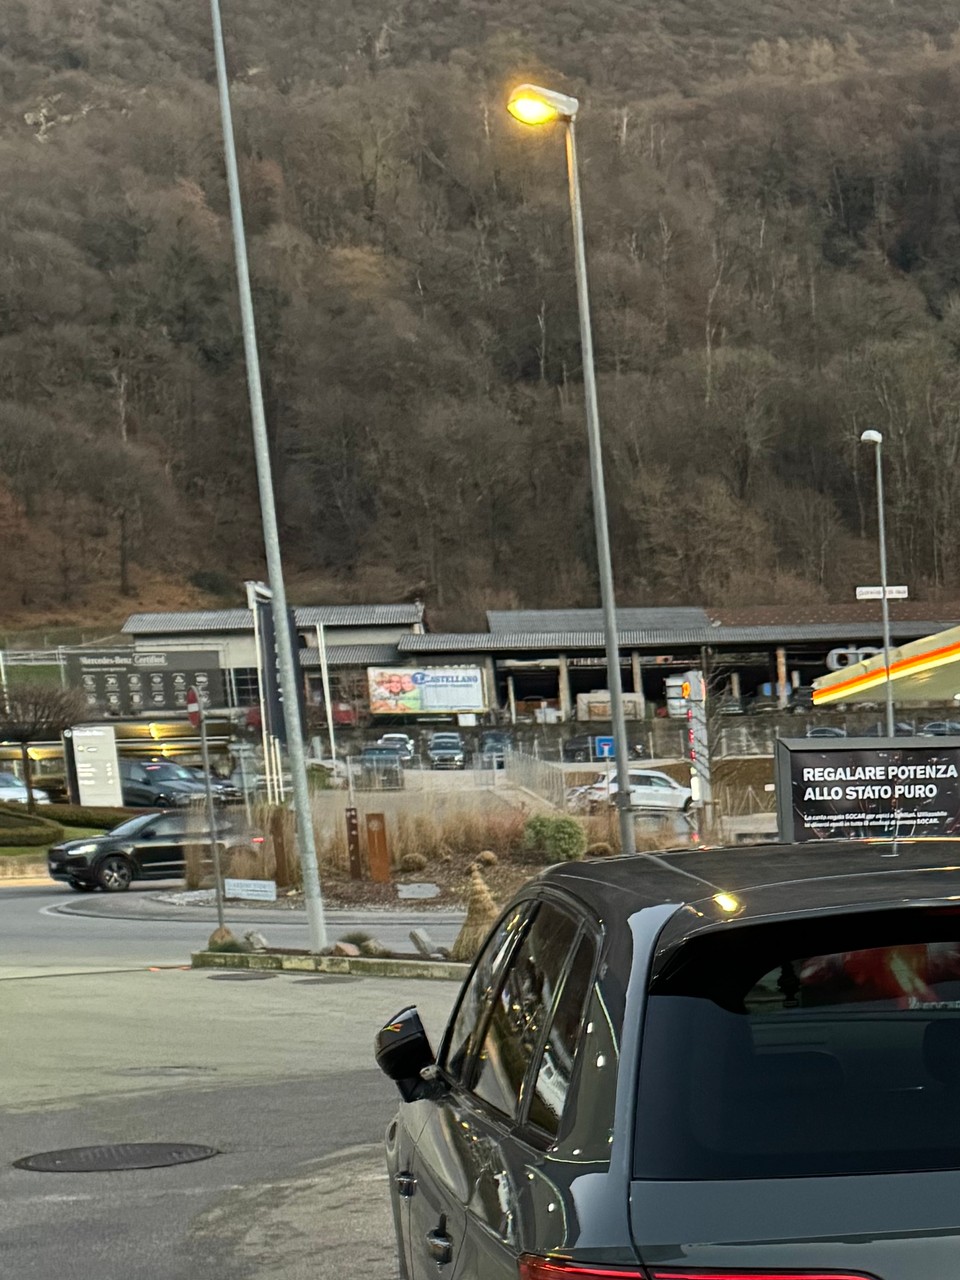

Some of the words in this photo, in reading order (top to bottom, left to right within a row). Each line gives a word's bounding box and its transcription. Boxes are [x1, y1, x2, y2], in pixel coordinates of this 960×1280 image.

[803, 767, 885, 781] REGALARE
[887, 765, 958, 780] POTENZA
[803, 787, 842, 801] ALLO
[846, 785, 891, 800] STATO
[895, 784, 938, 798] PURO
